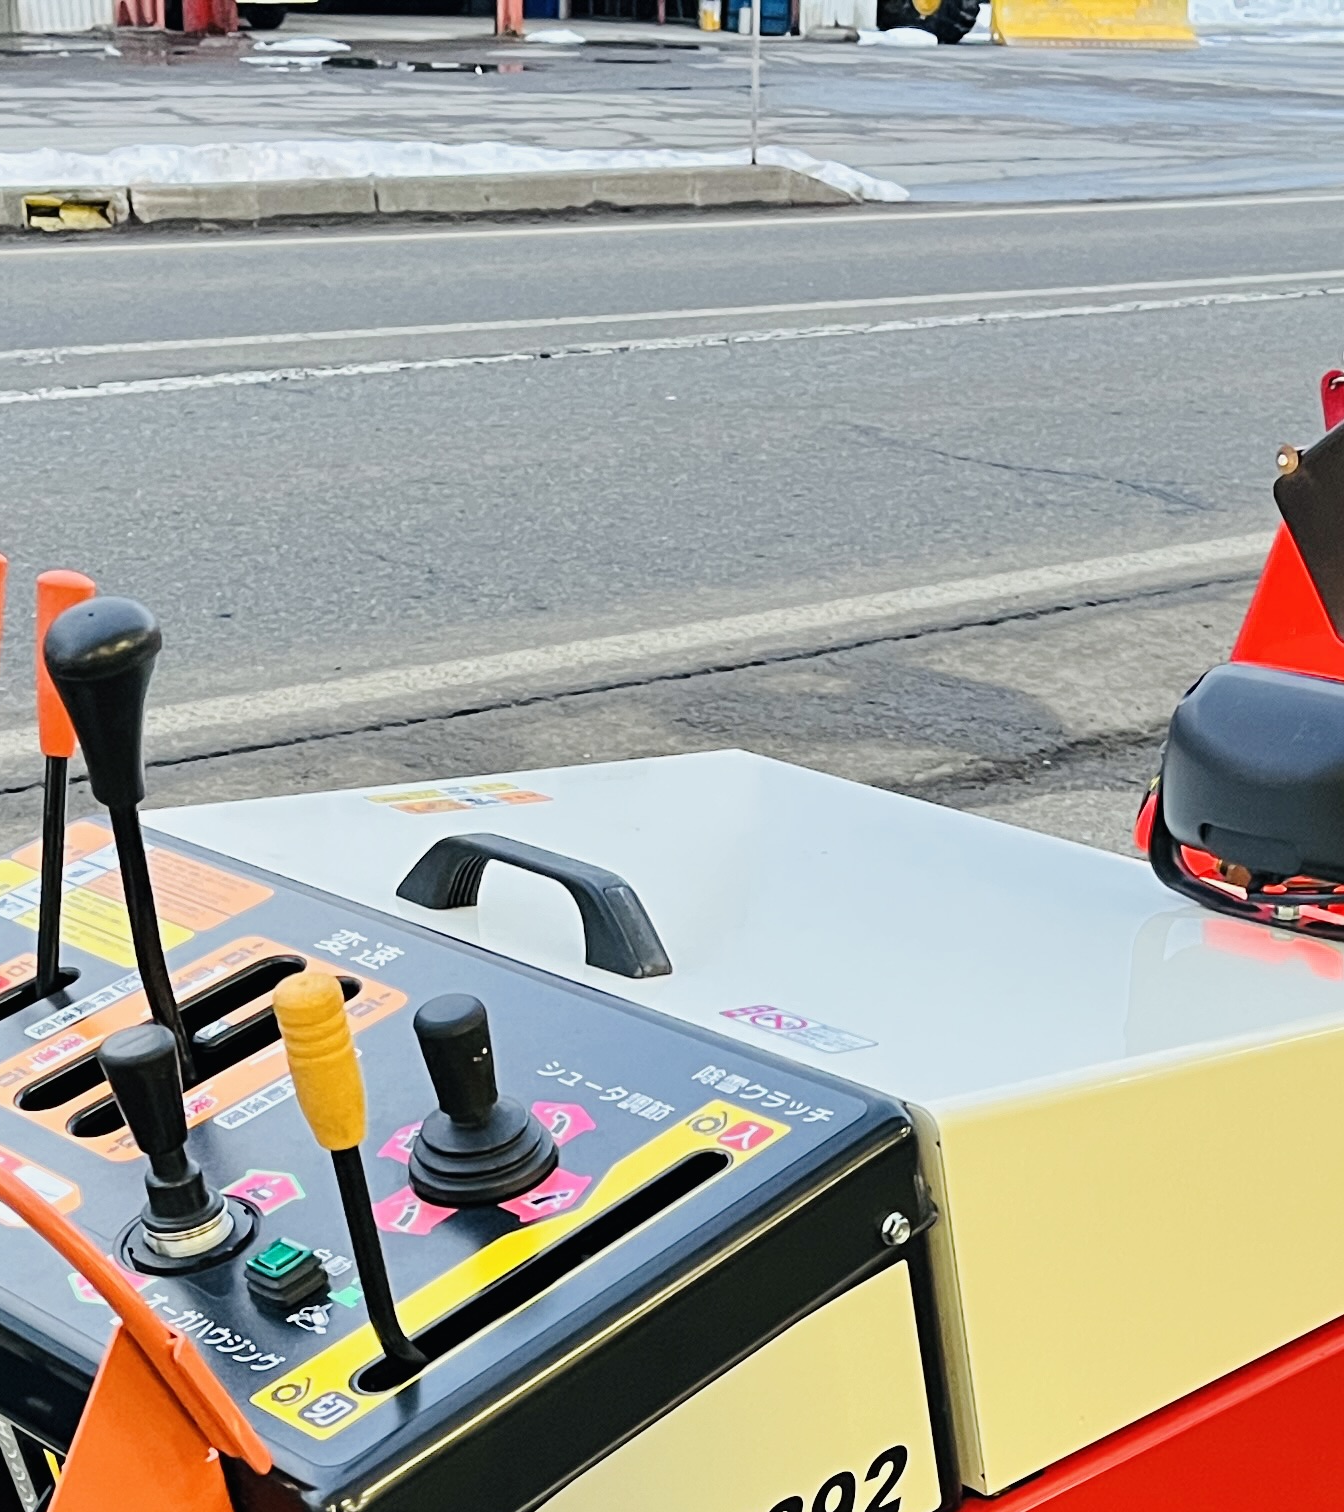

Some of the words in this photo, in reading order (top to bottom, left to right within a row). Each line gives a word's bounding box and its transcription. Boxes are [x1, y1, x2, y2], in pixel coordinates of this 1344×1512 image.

[313, 929, 405, 970] 変速
[536, 1060, 676, 1122] シュータ調節
[690, 1064, 835, 1123] 除雪クラッチ
[718, 1124, 760, 1150] 入
[144, 1292, 286, 1371] オーガハウジング
[303, 1393, 354, 1426] 切
